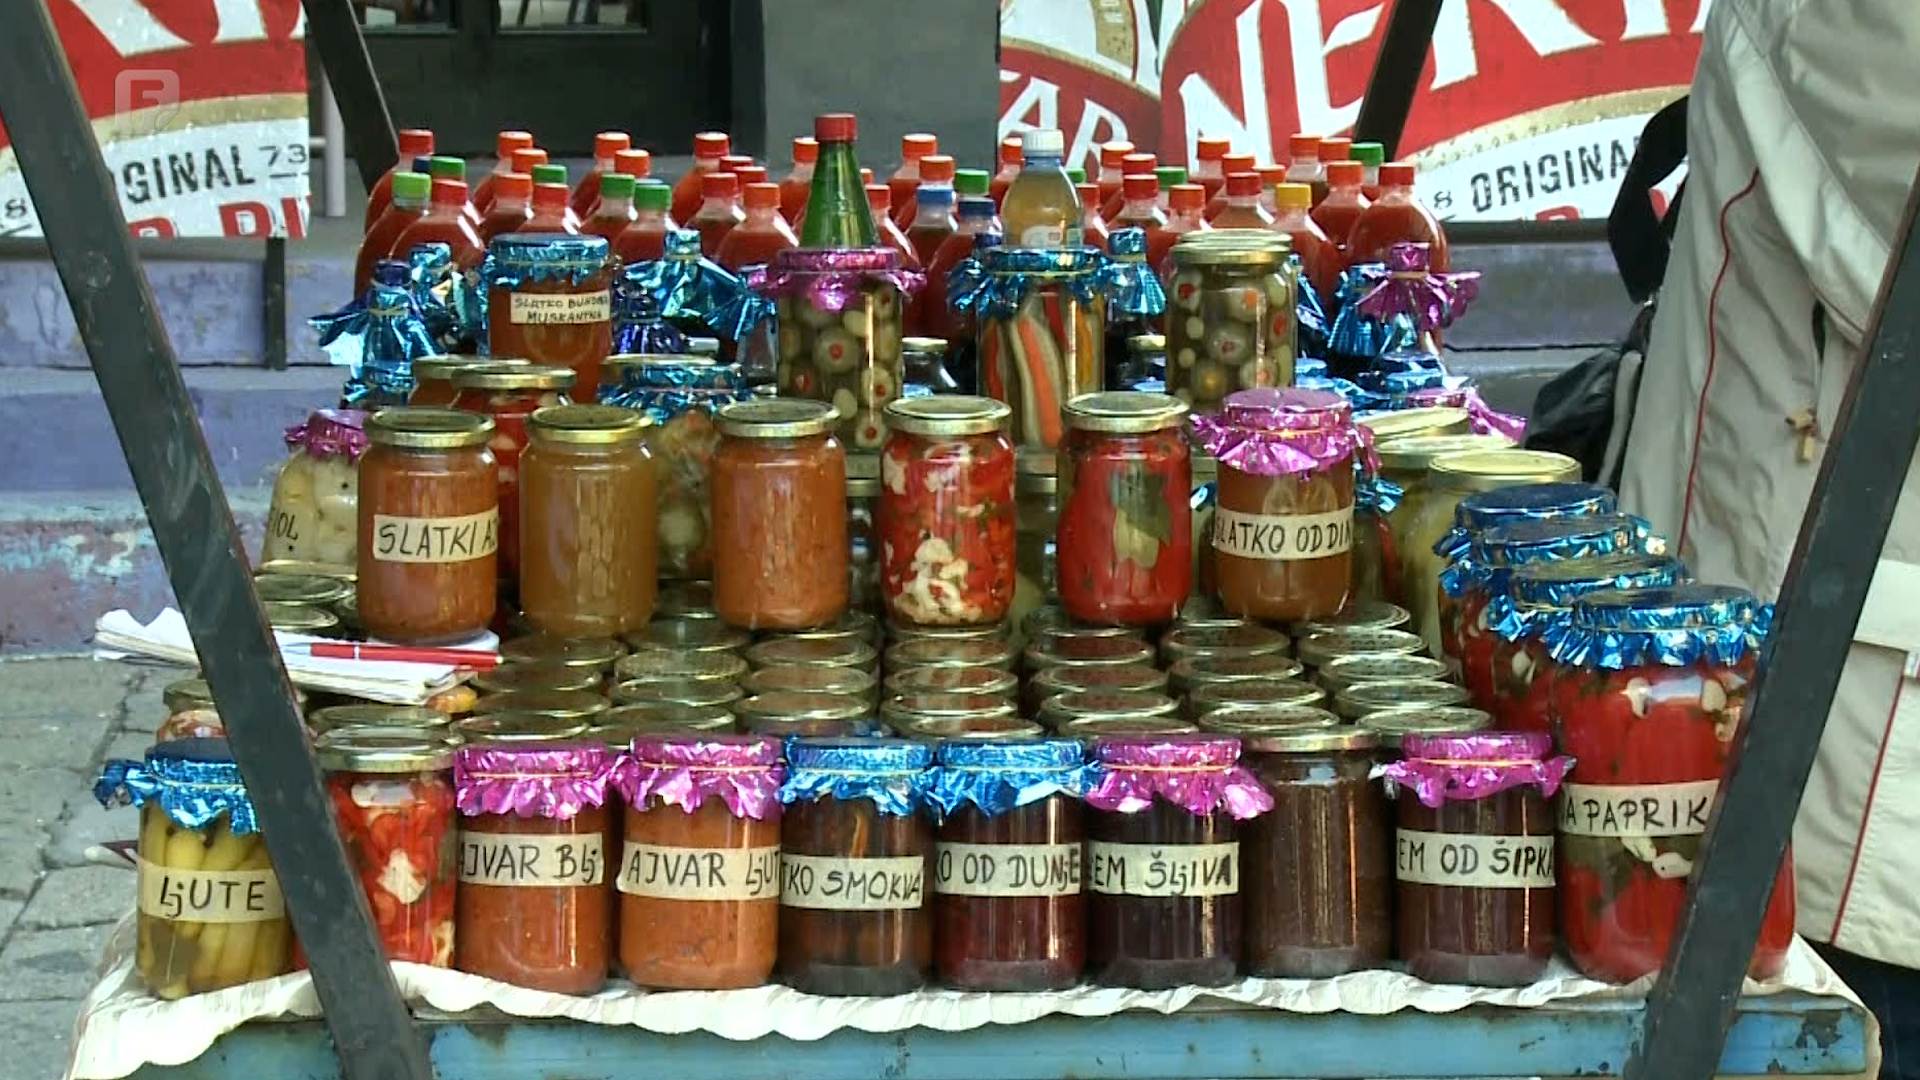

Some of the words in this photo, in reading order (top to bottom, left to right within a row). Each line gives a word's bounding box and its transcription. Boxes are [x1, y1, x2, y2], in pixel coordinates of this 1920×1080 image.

[378, 520, 478, 559] SLATKI
[627, 850, 728, 888] AJVAR
[963, 852, 995, 885] OD
[1440, 844, 1478, 875] OD
